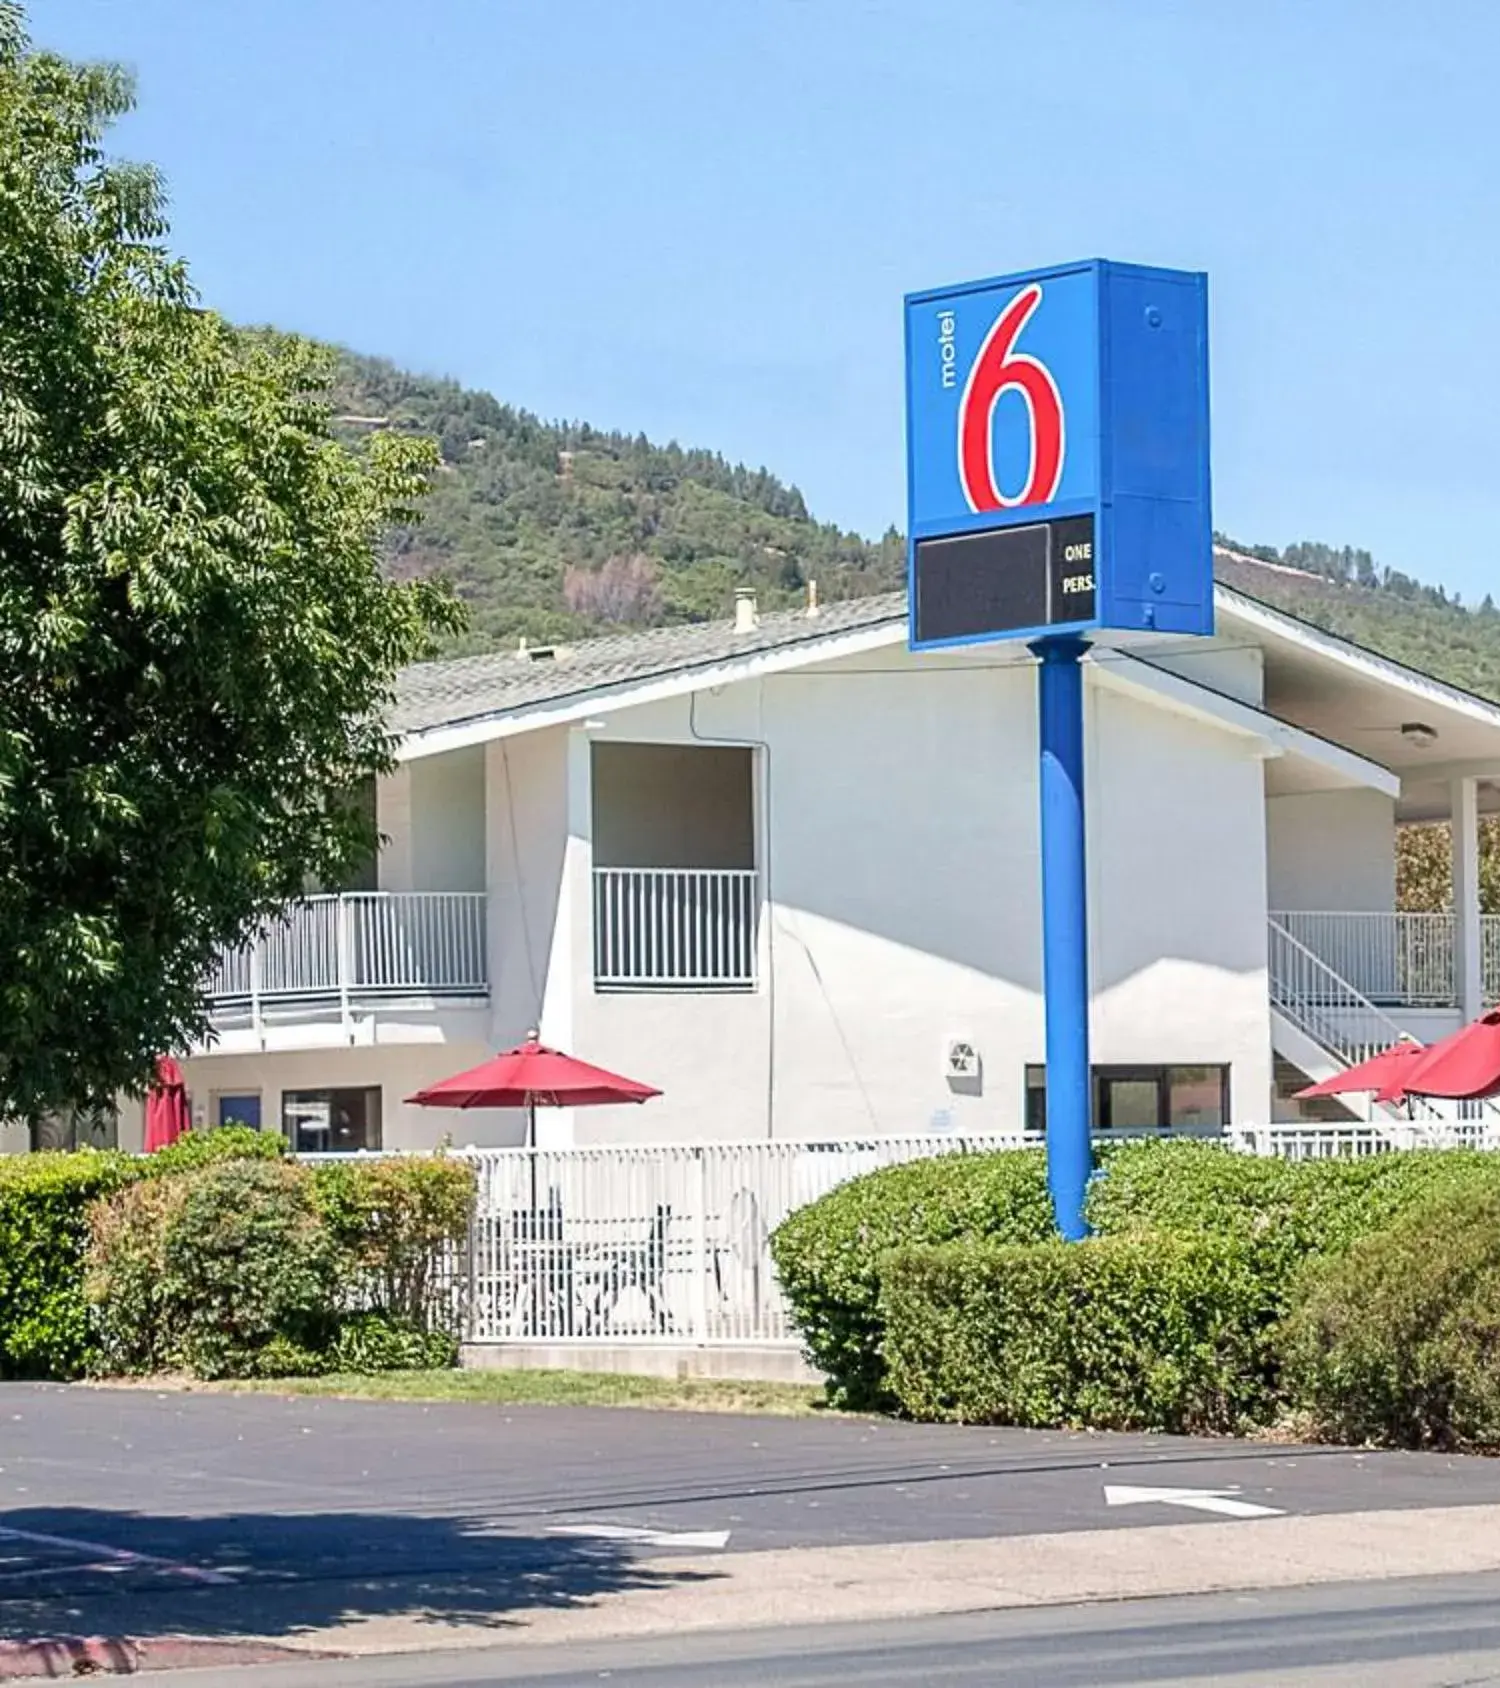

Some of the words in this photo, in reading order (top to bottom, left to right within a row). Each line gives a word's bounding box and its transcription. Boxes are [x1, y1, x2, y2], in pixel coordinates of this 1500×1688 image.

[936, 311, 956, 387] motel
[958, 283, 1065, 514] 6
[1065, 543, 1092, 561] ONE
